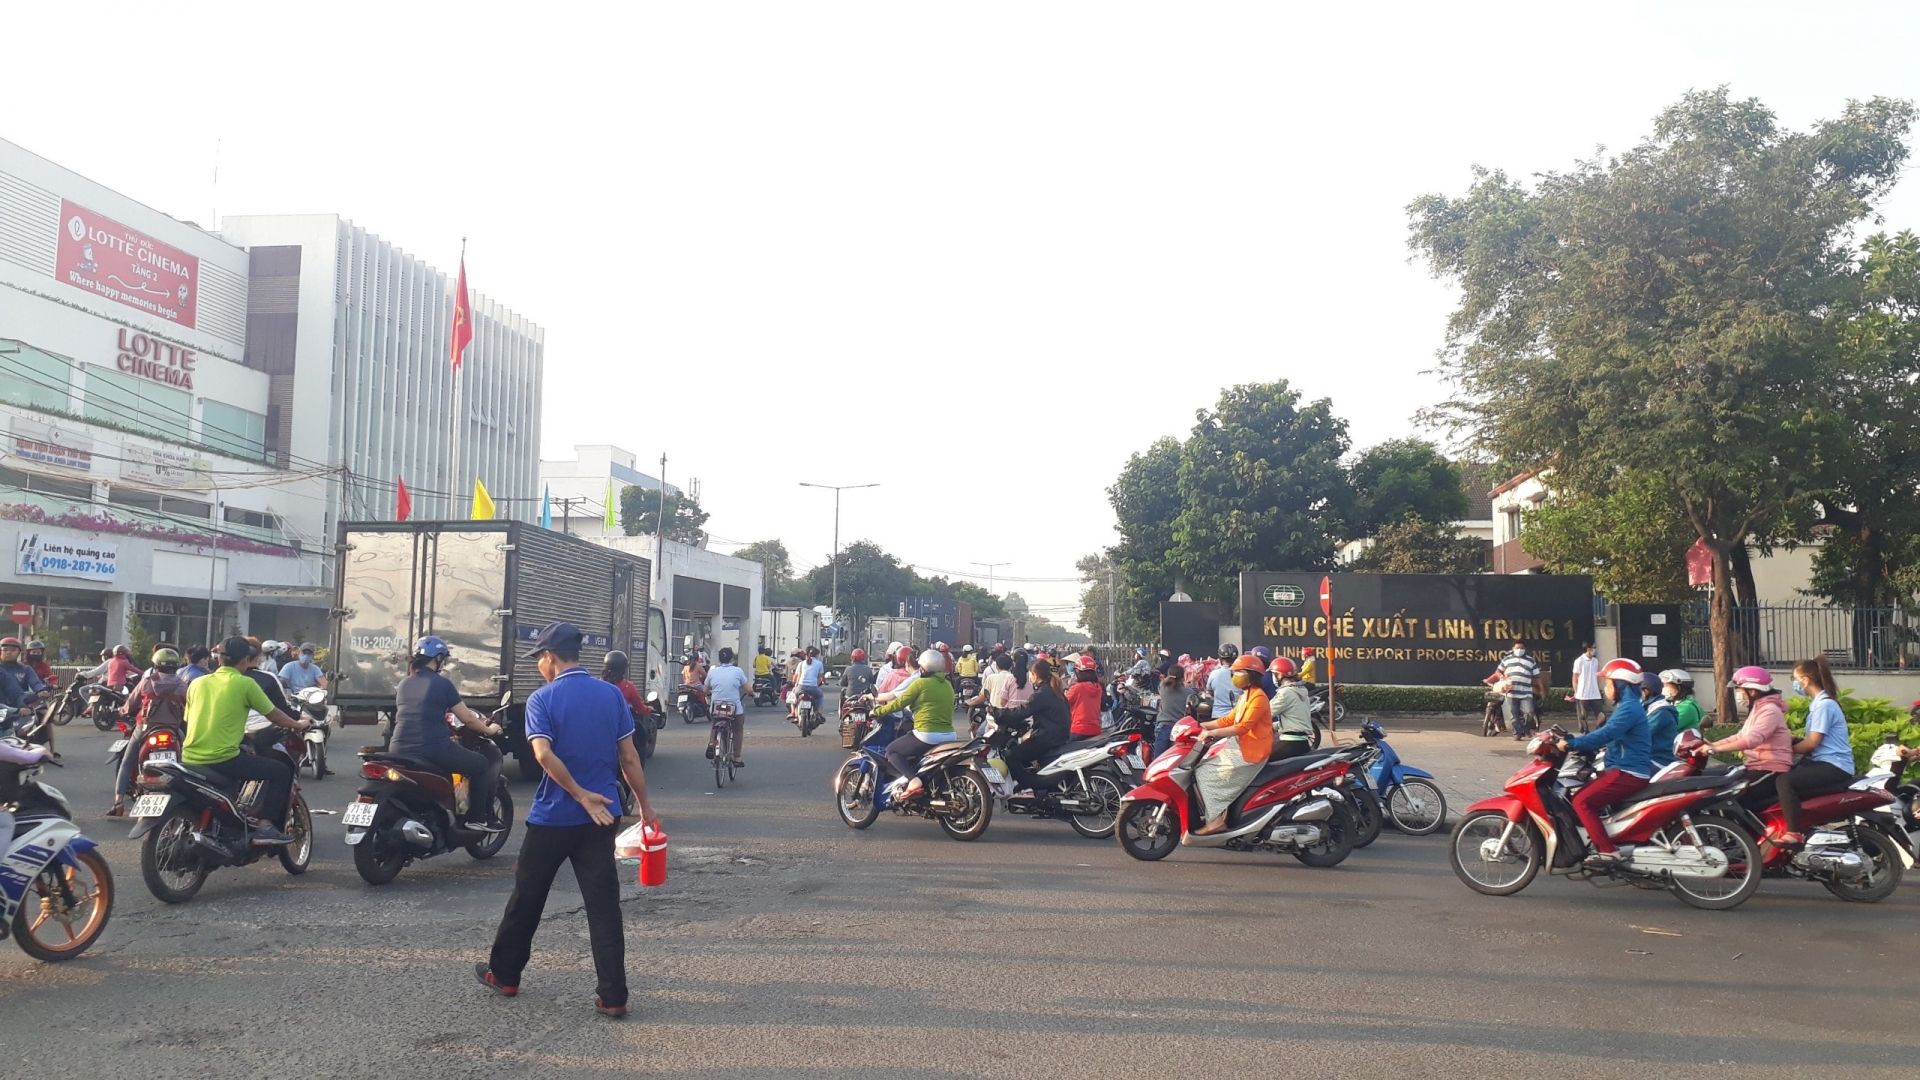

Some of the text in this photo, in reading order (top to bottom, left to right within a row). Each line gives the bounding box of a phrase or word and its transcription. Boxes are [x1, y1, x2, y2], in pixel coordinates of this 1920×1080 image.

[88, 226, 189, 280] LOTTE CINEMA
[152, 272, 158, 282] 2
[69, 270, 178, 320] Where happy memories begin
[118, 327, 196, 372] LOTTE
[116, 352, 194, 390] CINEMA
[42, 556, 115, 574] 0918-287-766
[44, 543, 116, 560] Liên hệ quảng cáo
[1263, 606, 1574, 640] KHU CHẾ XUẤT LINH TRUNG 1
[1357, 648, 1412, 661] EXPORT
[1556, 651, 1562, 662] 1
